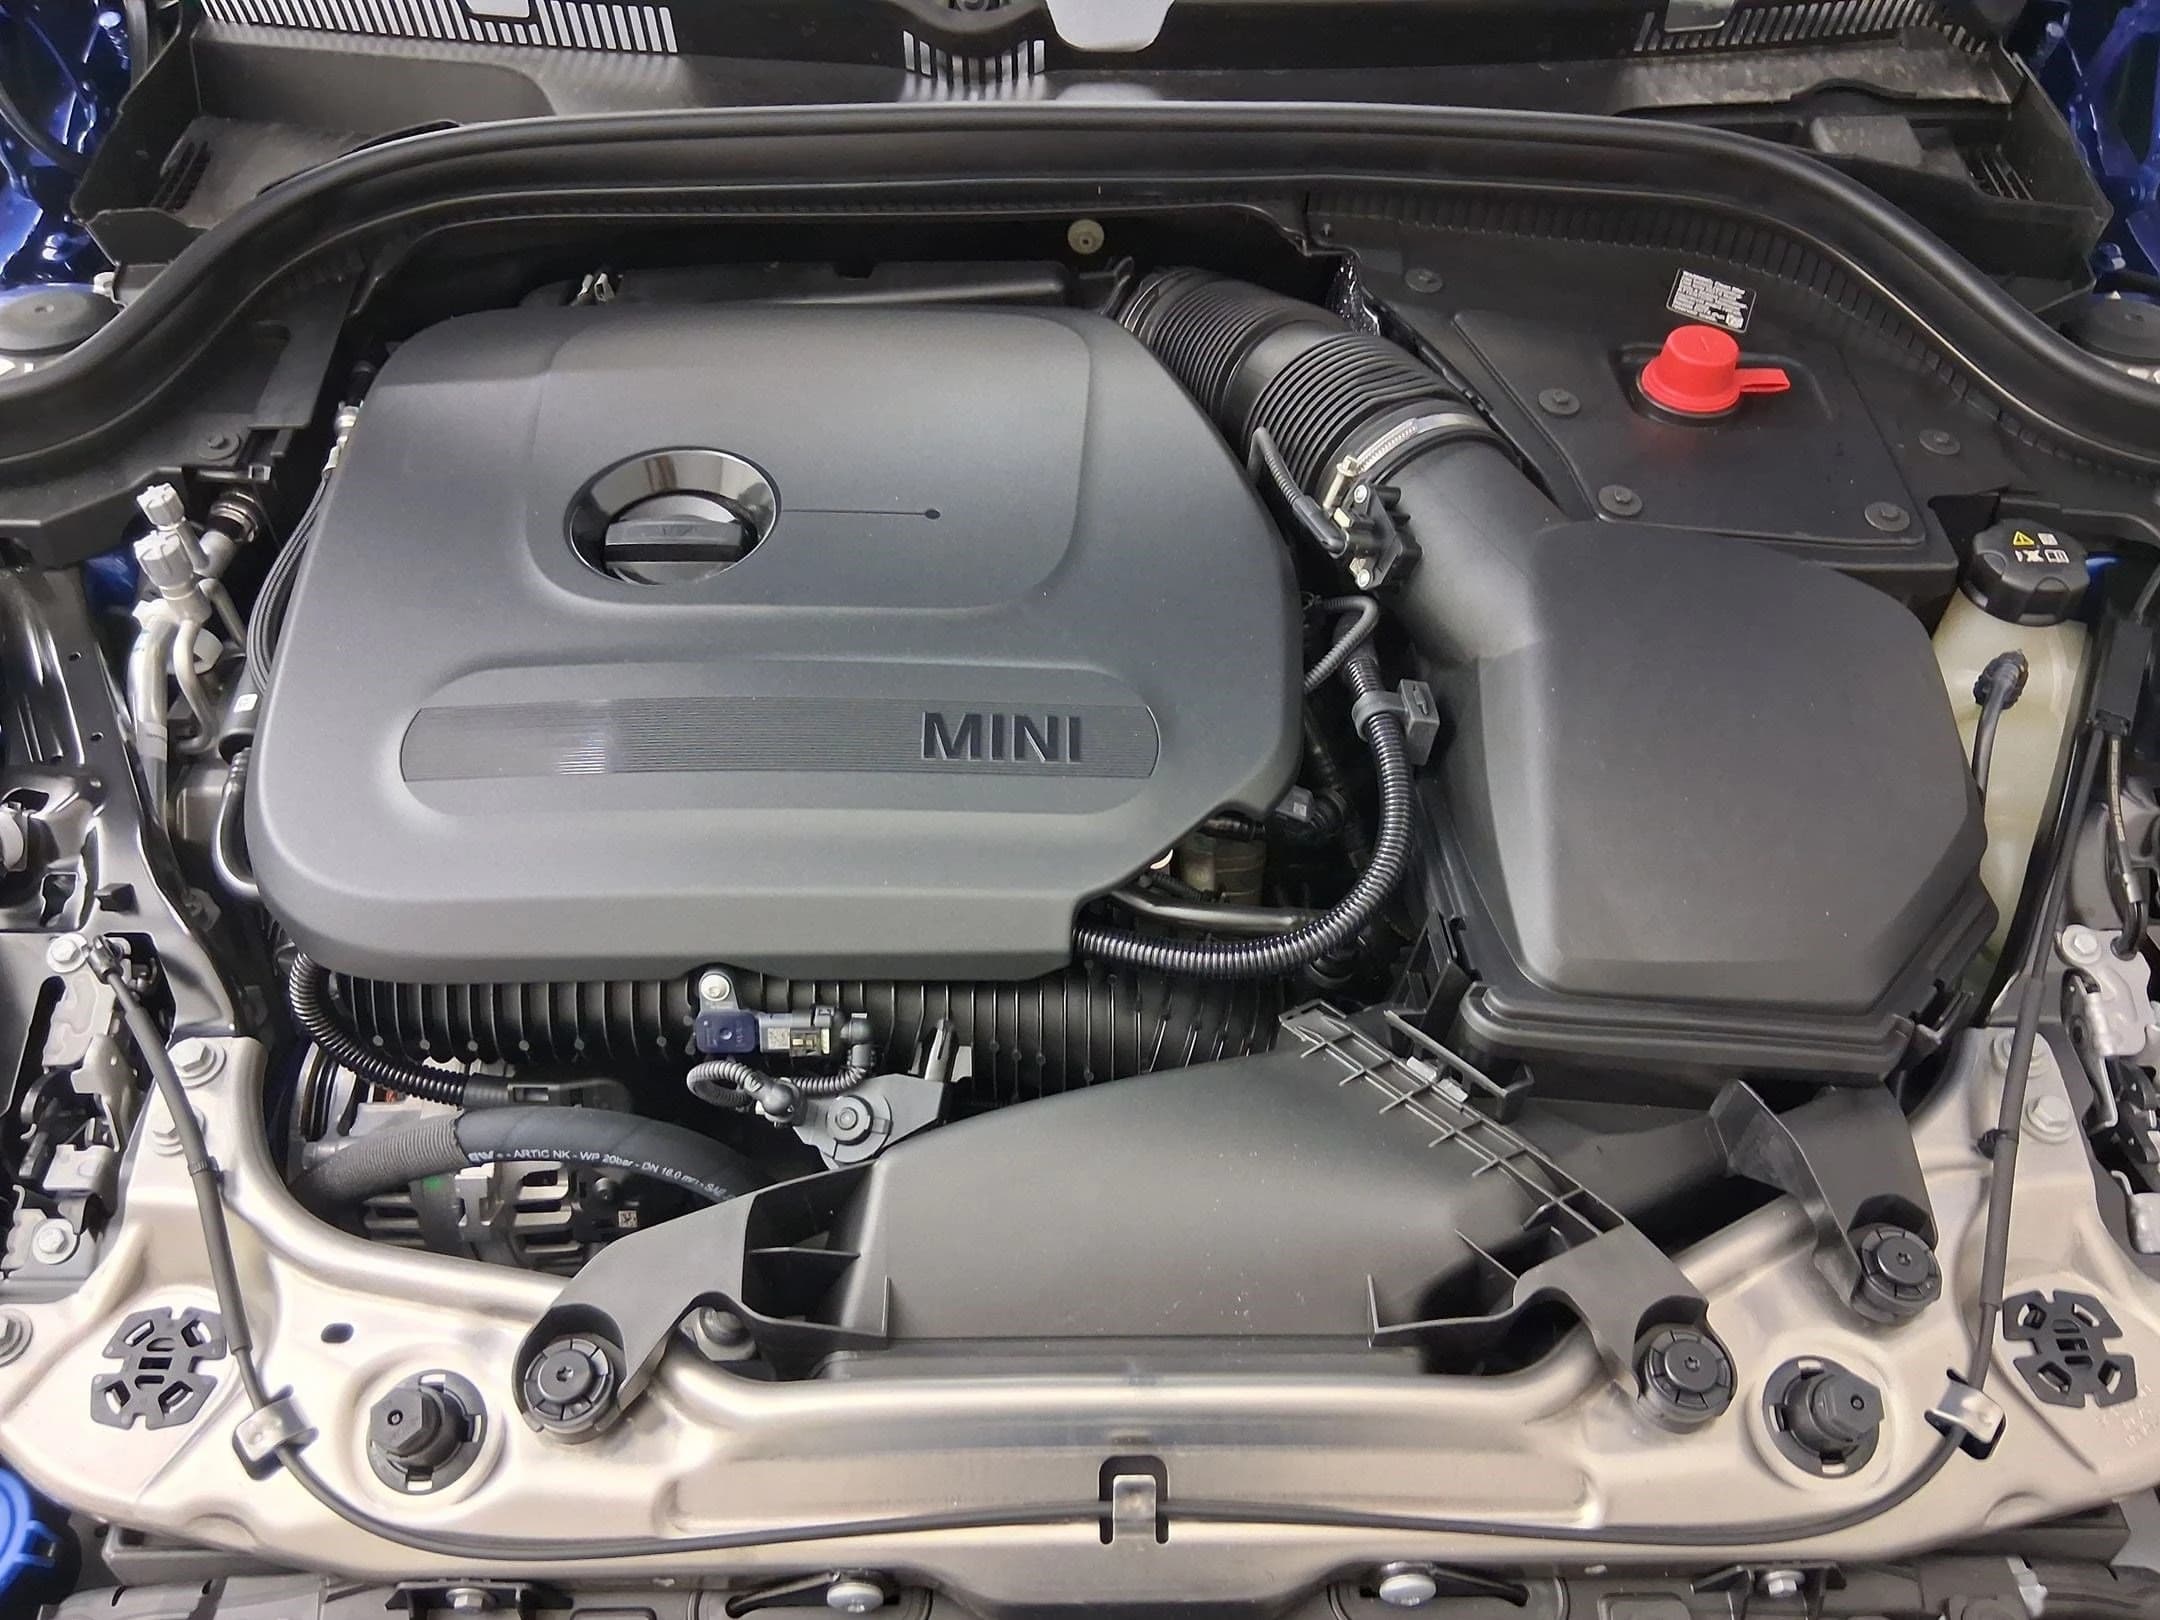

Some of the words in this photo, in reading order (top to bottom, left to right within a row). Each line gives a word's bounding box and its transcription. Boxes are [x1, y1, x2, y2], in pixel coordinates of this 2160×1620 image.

[920, 711, 1082, 764] MINI
[513, 1149, 550, 1159] ARTIC
[552, 1150, 571, 1160] NK
[580, 1151, 600, 1161] WP
[602, 1153, 634, 1168] 20bar
[642, 1161, 660, 1174] DN
